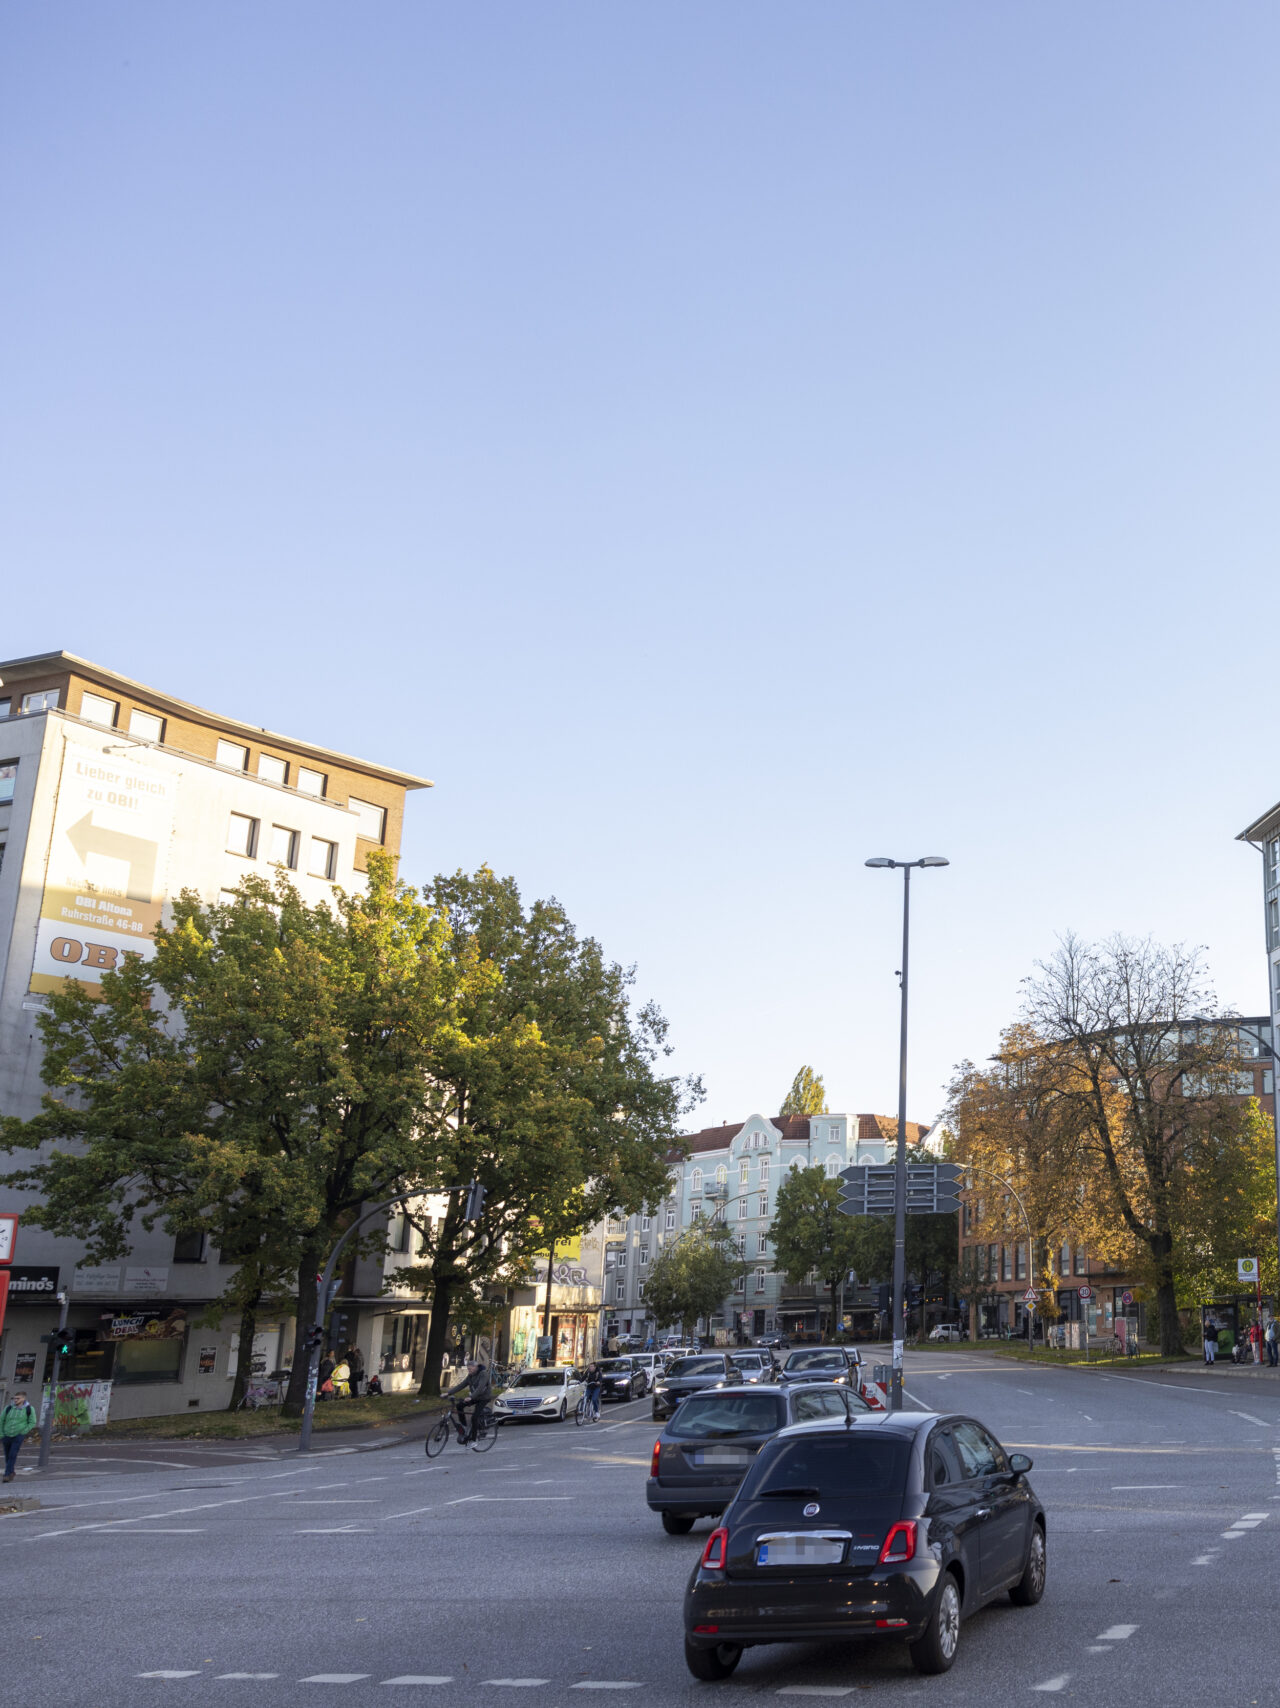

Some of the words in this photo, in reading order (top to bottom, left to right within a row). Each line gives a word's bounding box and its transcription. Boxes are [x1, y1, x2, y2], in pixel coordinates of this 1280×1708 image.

[76, 761, 121, 785] Lieber
[125, 776, 166, 797] gleich
[87, 789, 103, 801] zu
[107, 791, 139, 810] OBI!
[75, 895, 97, 909] OBI
[98, 900, 133, 917] Altona
[61, 906, 114, 927] Ruhrstraße
[116, 919, 144, 933] 46-88
[1080, 1288, 1089, 1297] 30
[111, 1316, 145, 1328] LUNCH
[113, 1326, 140, 1336] DEAL
